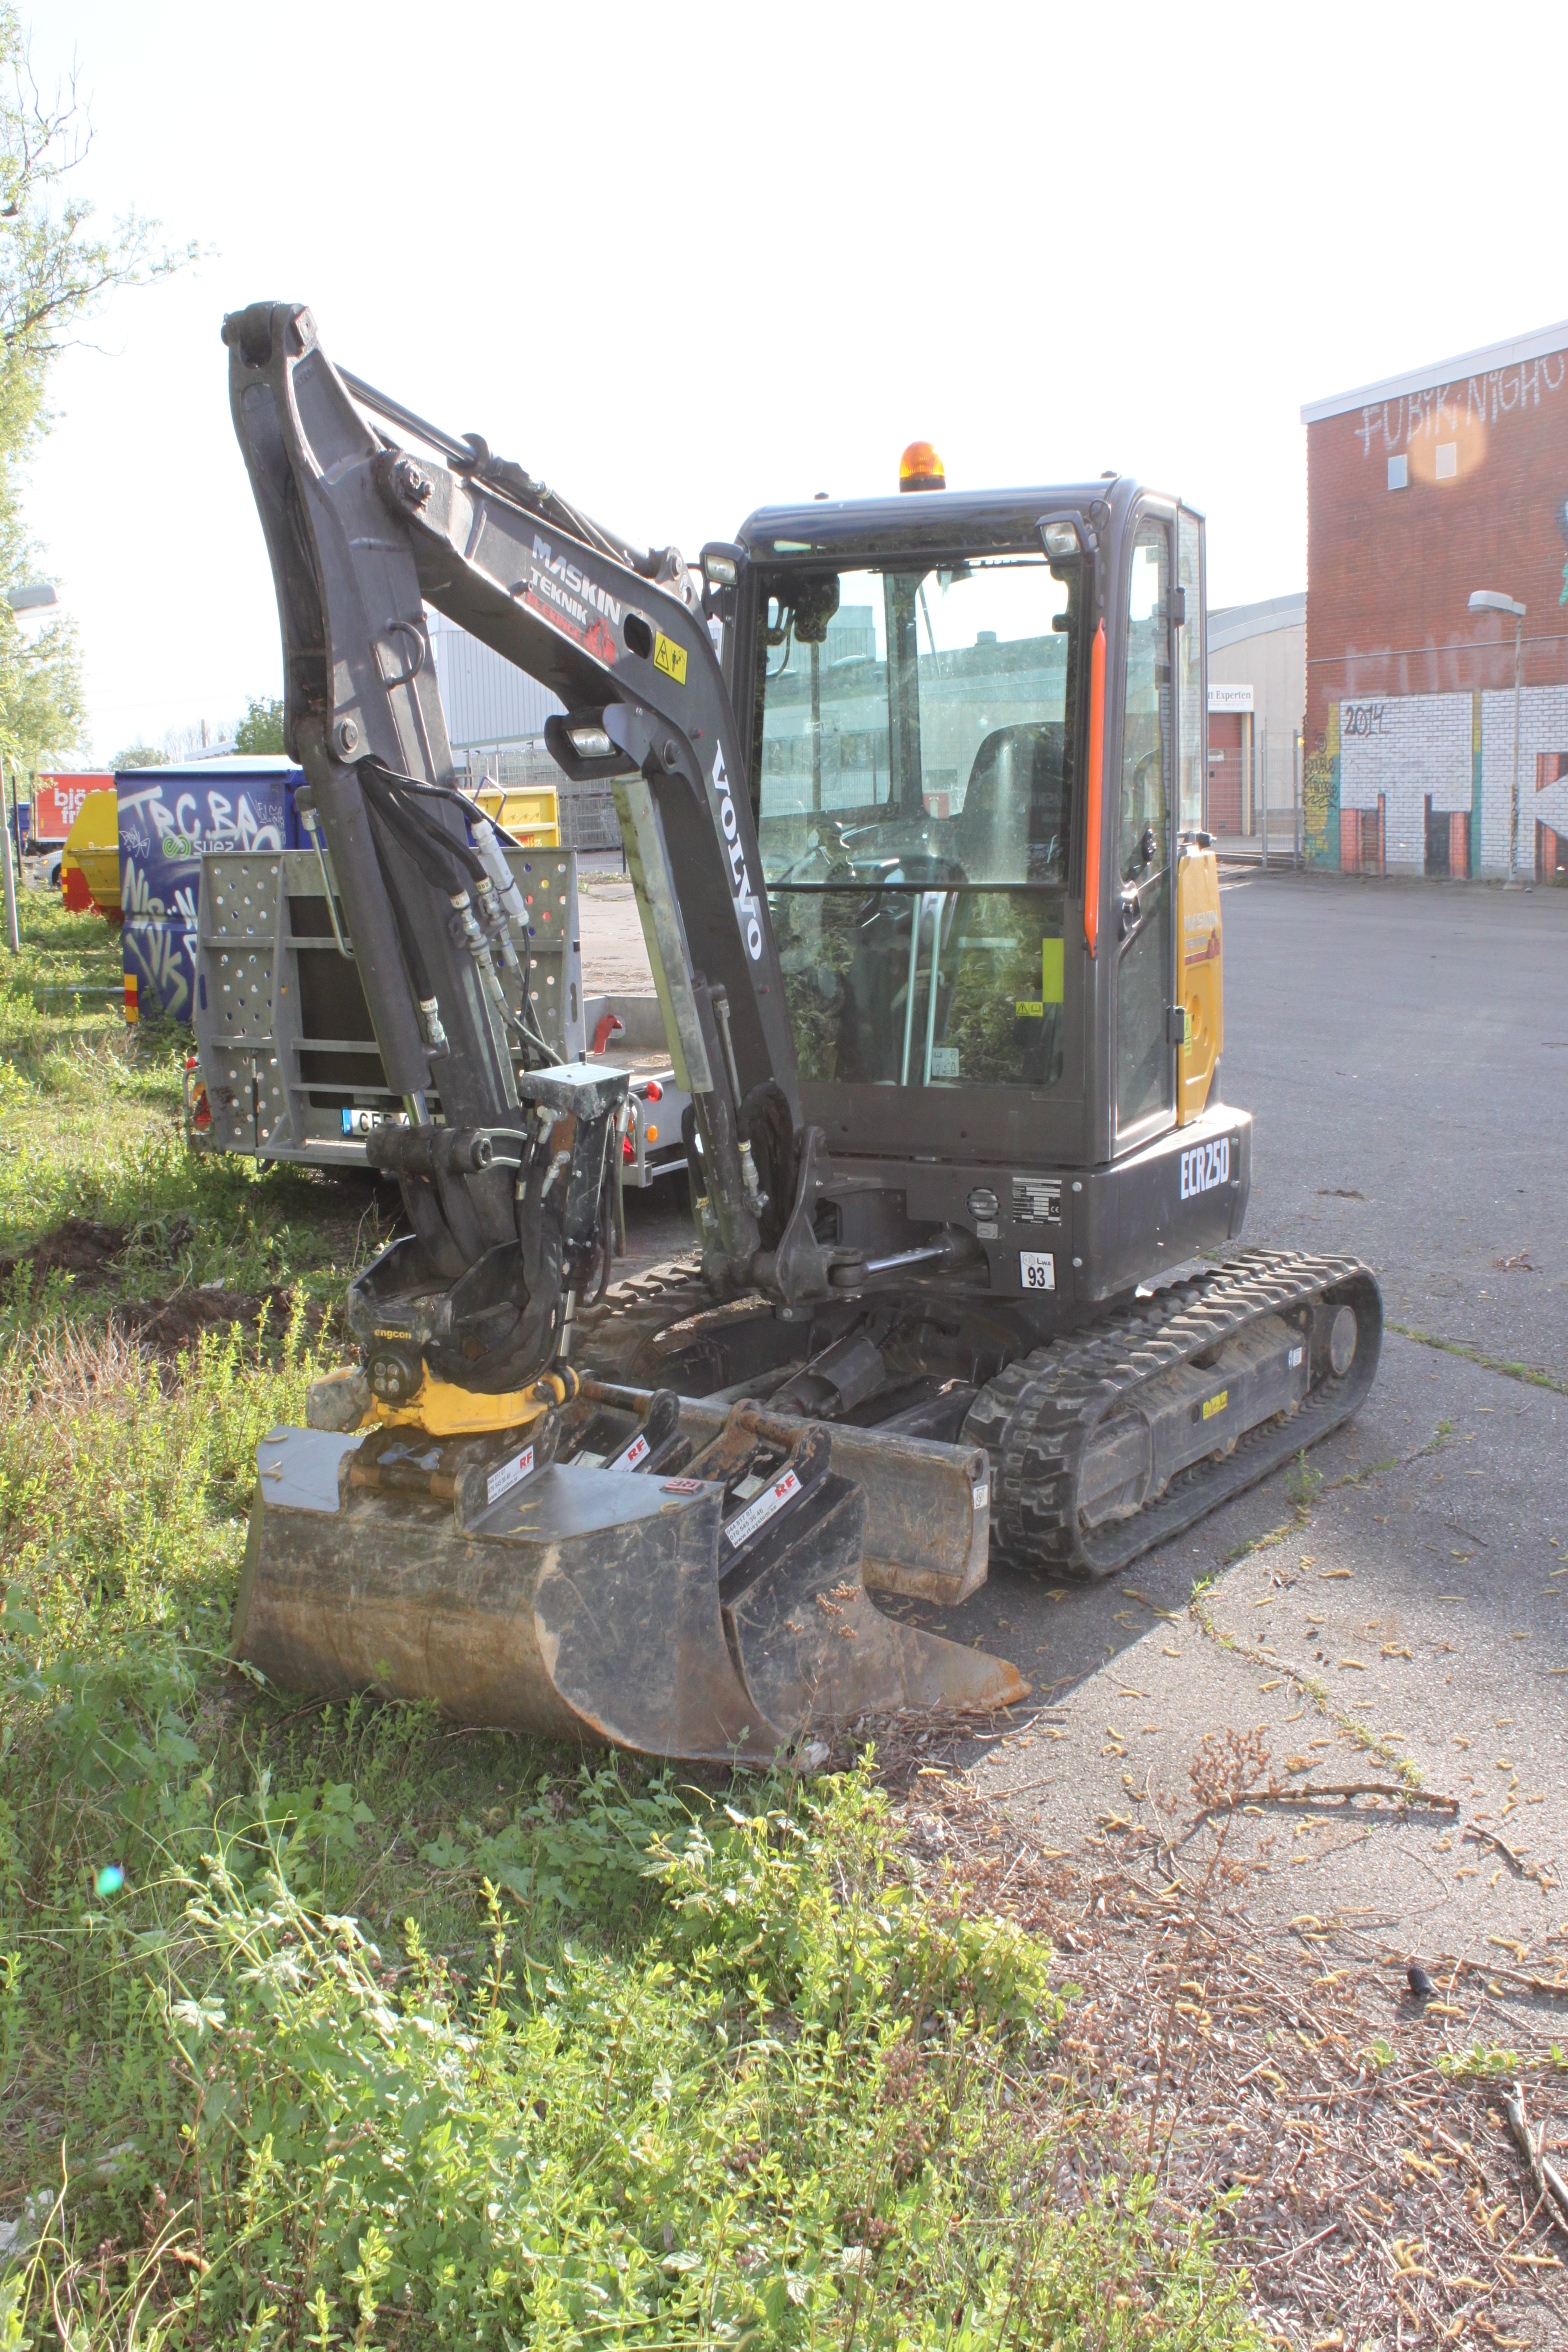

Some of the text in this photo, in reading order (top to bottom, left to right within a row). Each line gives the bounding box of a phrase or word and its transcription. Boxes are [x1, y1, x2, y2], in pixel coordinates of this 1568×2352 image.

[532, 534, 621, 626] MASKIN
[530, 566, 588, 625] TEKNIK
[1216, 690, 1251, 702] Experten
[712, 739, 763, 960] VOLVO
[1181, 1137, 1230, 1200] ECR25D
[1028, 1266, 1046, 1287] 93
[374, 1329, 412, 1340] engcon
[520, 1451, 533, 1469] RF
[627, 1440, 645, 1461] RF
[775, 1474, 796, 1498] RF
[740, 1522, 750, 1531] 545
